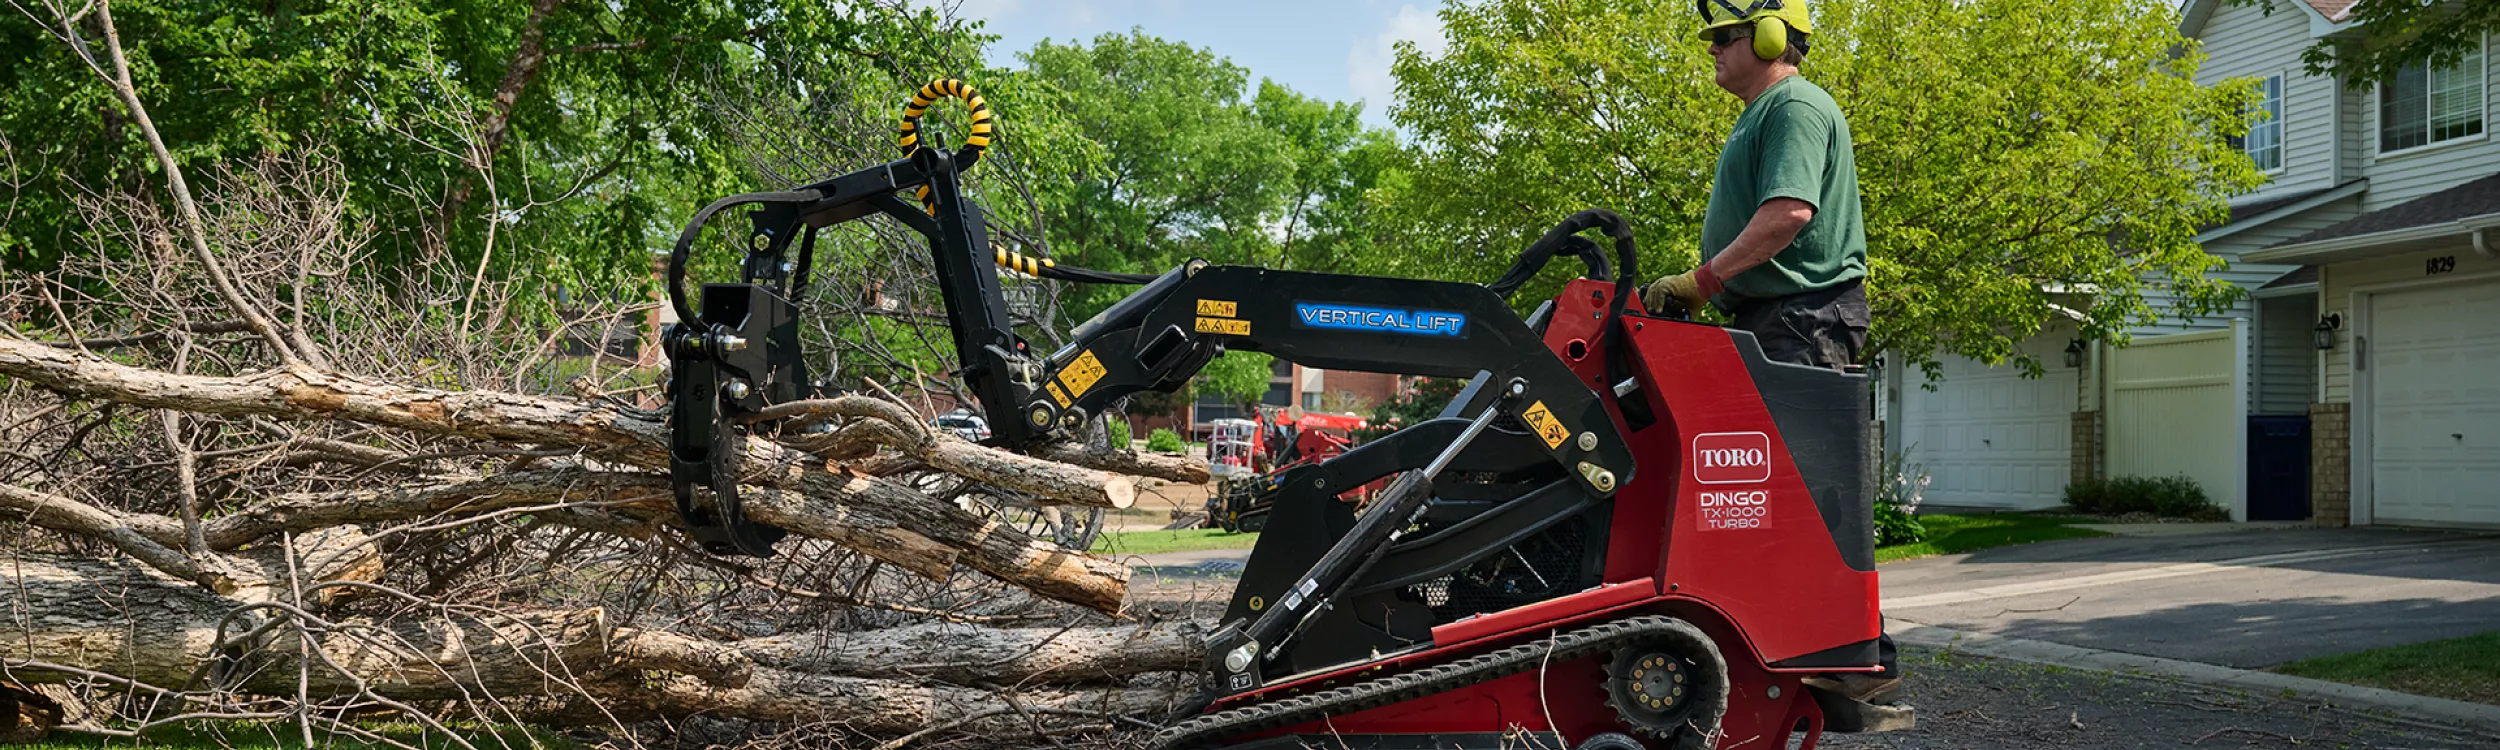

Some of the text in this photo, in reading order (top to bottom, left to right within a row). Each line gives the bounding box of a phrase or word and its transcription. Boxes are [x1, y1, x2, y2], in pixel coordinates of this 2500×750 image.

[2426, 256, 2455, 276] 1829
[1301, 308, 1461, 331] VERTICAL LIFT
[1700, 448, 1763, 467] TORO
[1700, 491, 1766, 506] DINGO
[1708, 518, 1760, 529] TURBO
